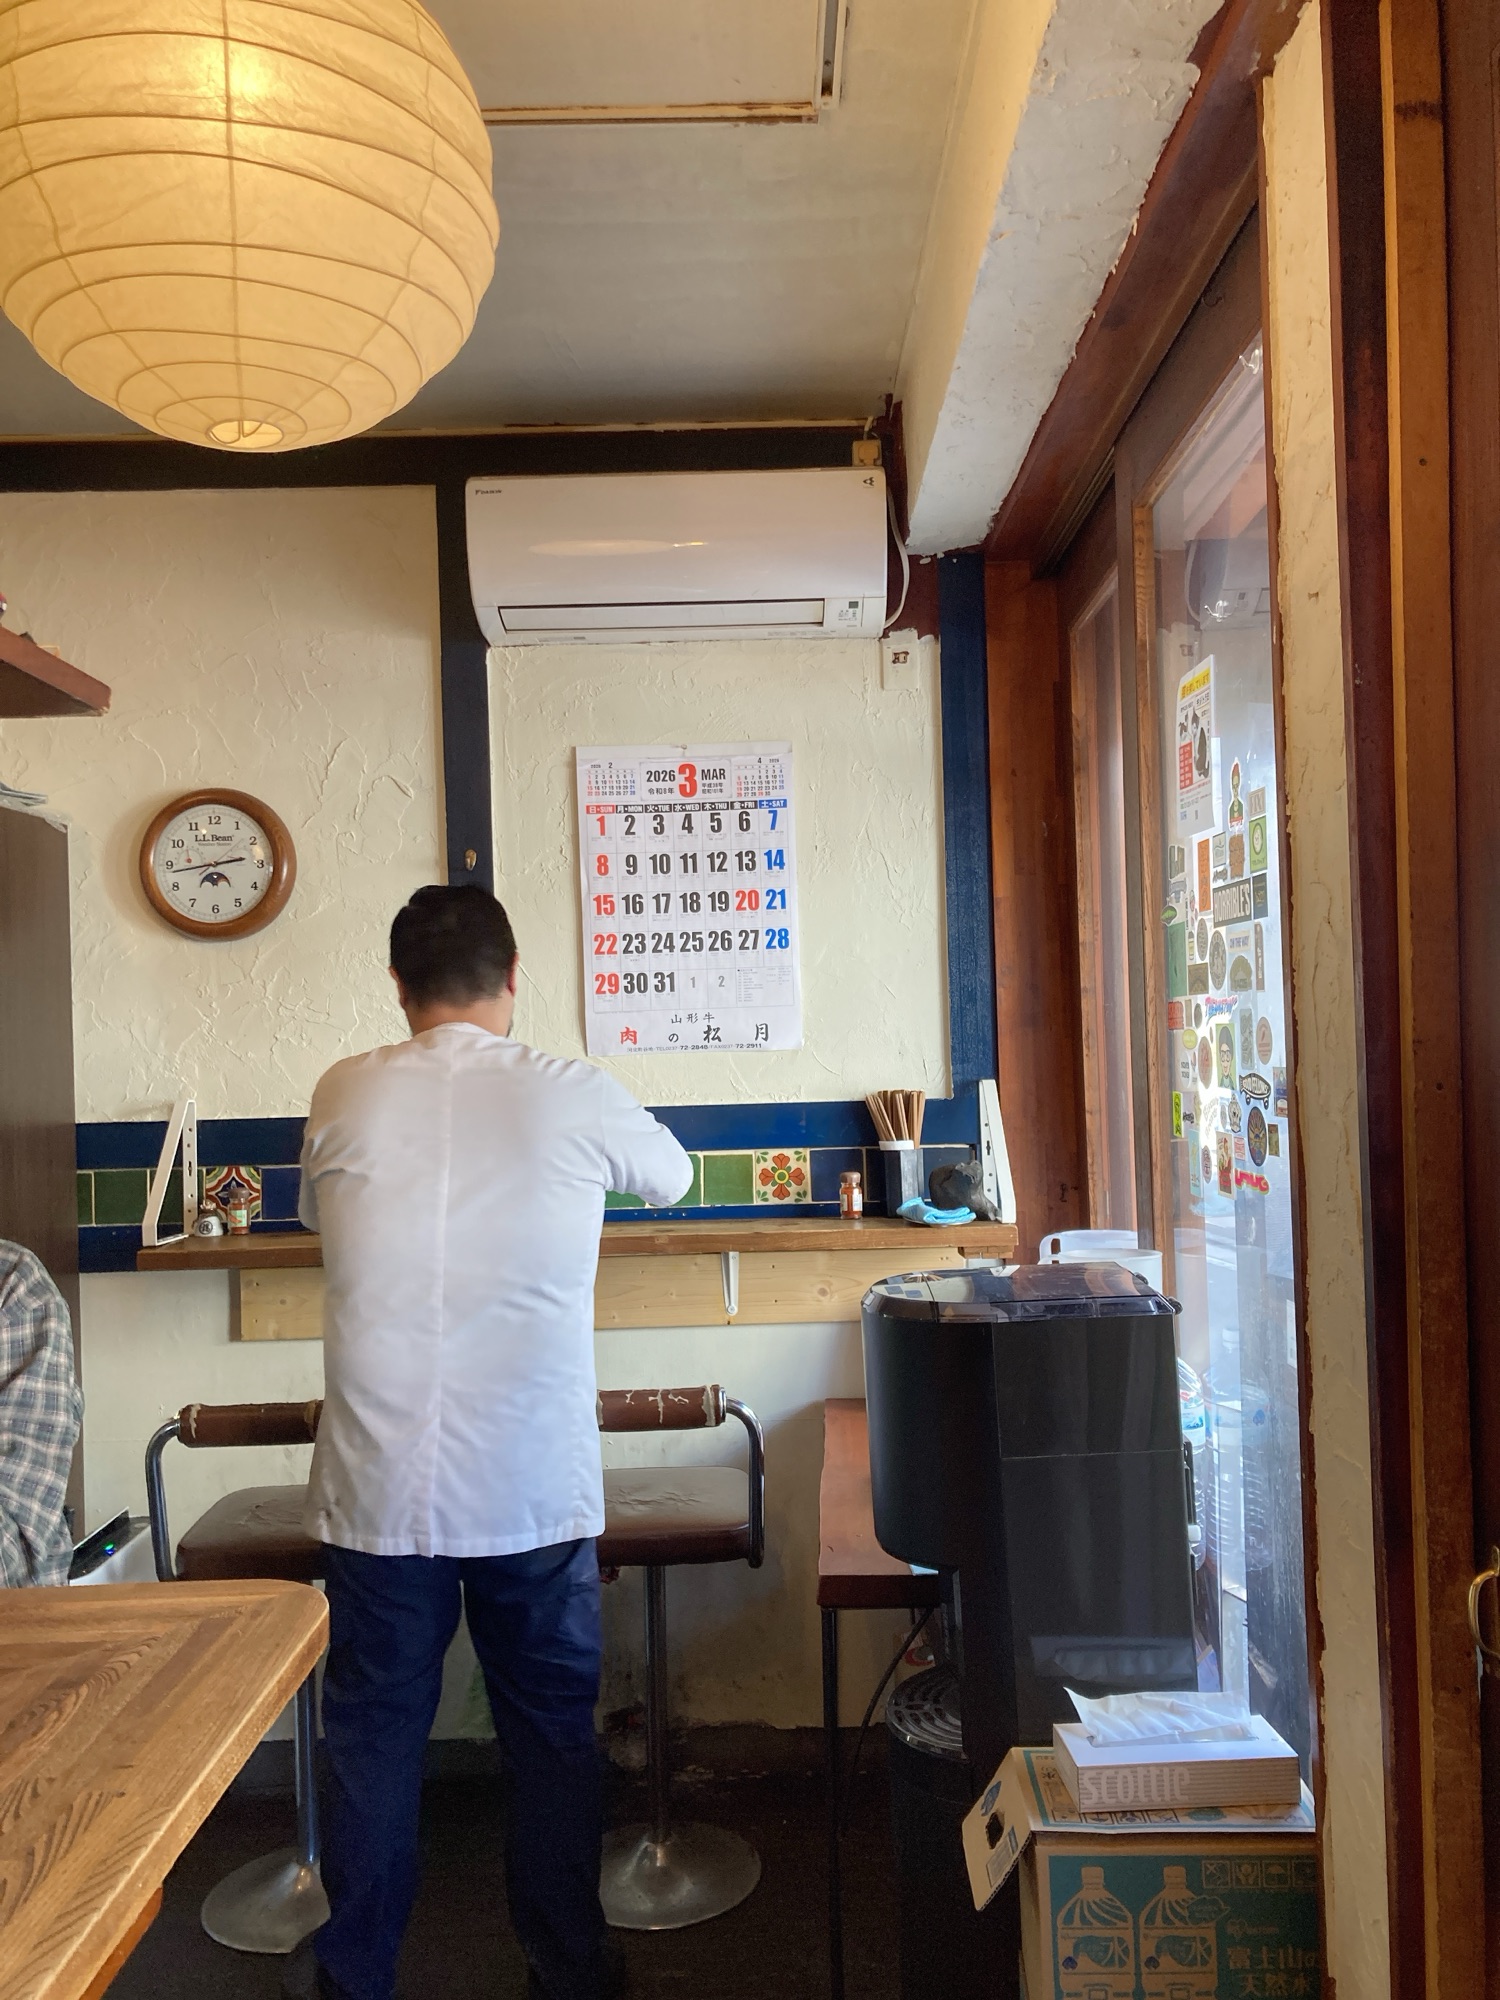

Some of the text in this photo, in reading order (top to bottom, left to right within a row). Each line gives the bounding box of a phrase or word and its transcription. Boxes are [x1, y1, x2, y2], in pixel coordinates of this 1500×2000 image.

[646, 764, 726, 798] 2026 3 MAR
[189, 822, 240, 831] 11 1
[208, 816, 221, 825] 12
[597, 810, 778, 836] 1 2 3 4 5 6 7
[172, 836, 257, 848] 10 2
[166, 860, 264, 870] 9 3
[597, 850, 785, 876] 8 9 10 11 12 13 14
[172, 882, 258, 891] 8 4
[189, 898, 242, 907] 7 5
[212, 904, 220, 913] 6
[593, 889, 786, 915] 15 16 17 18 19 20 21
[1214, 884, 1250, 922] HORRIBLE'S
[594, 928, 789, 955] 22 23 24 25 26 27 28
[595, 974, 620, 994] 29
[624, 973, 648, 994] 30
[654, 972, 675, 992] 31
[690, 976, 695, 988] 1
[719, 976, 725, 987] 2
[671, 1012, 714, 1024] 山形牛
[1080, 1766, 1190, 1805] scottie
